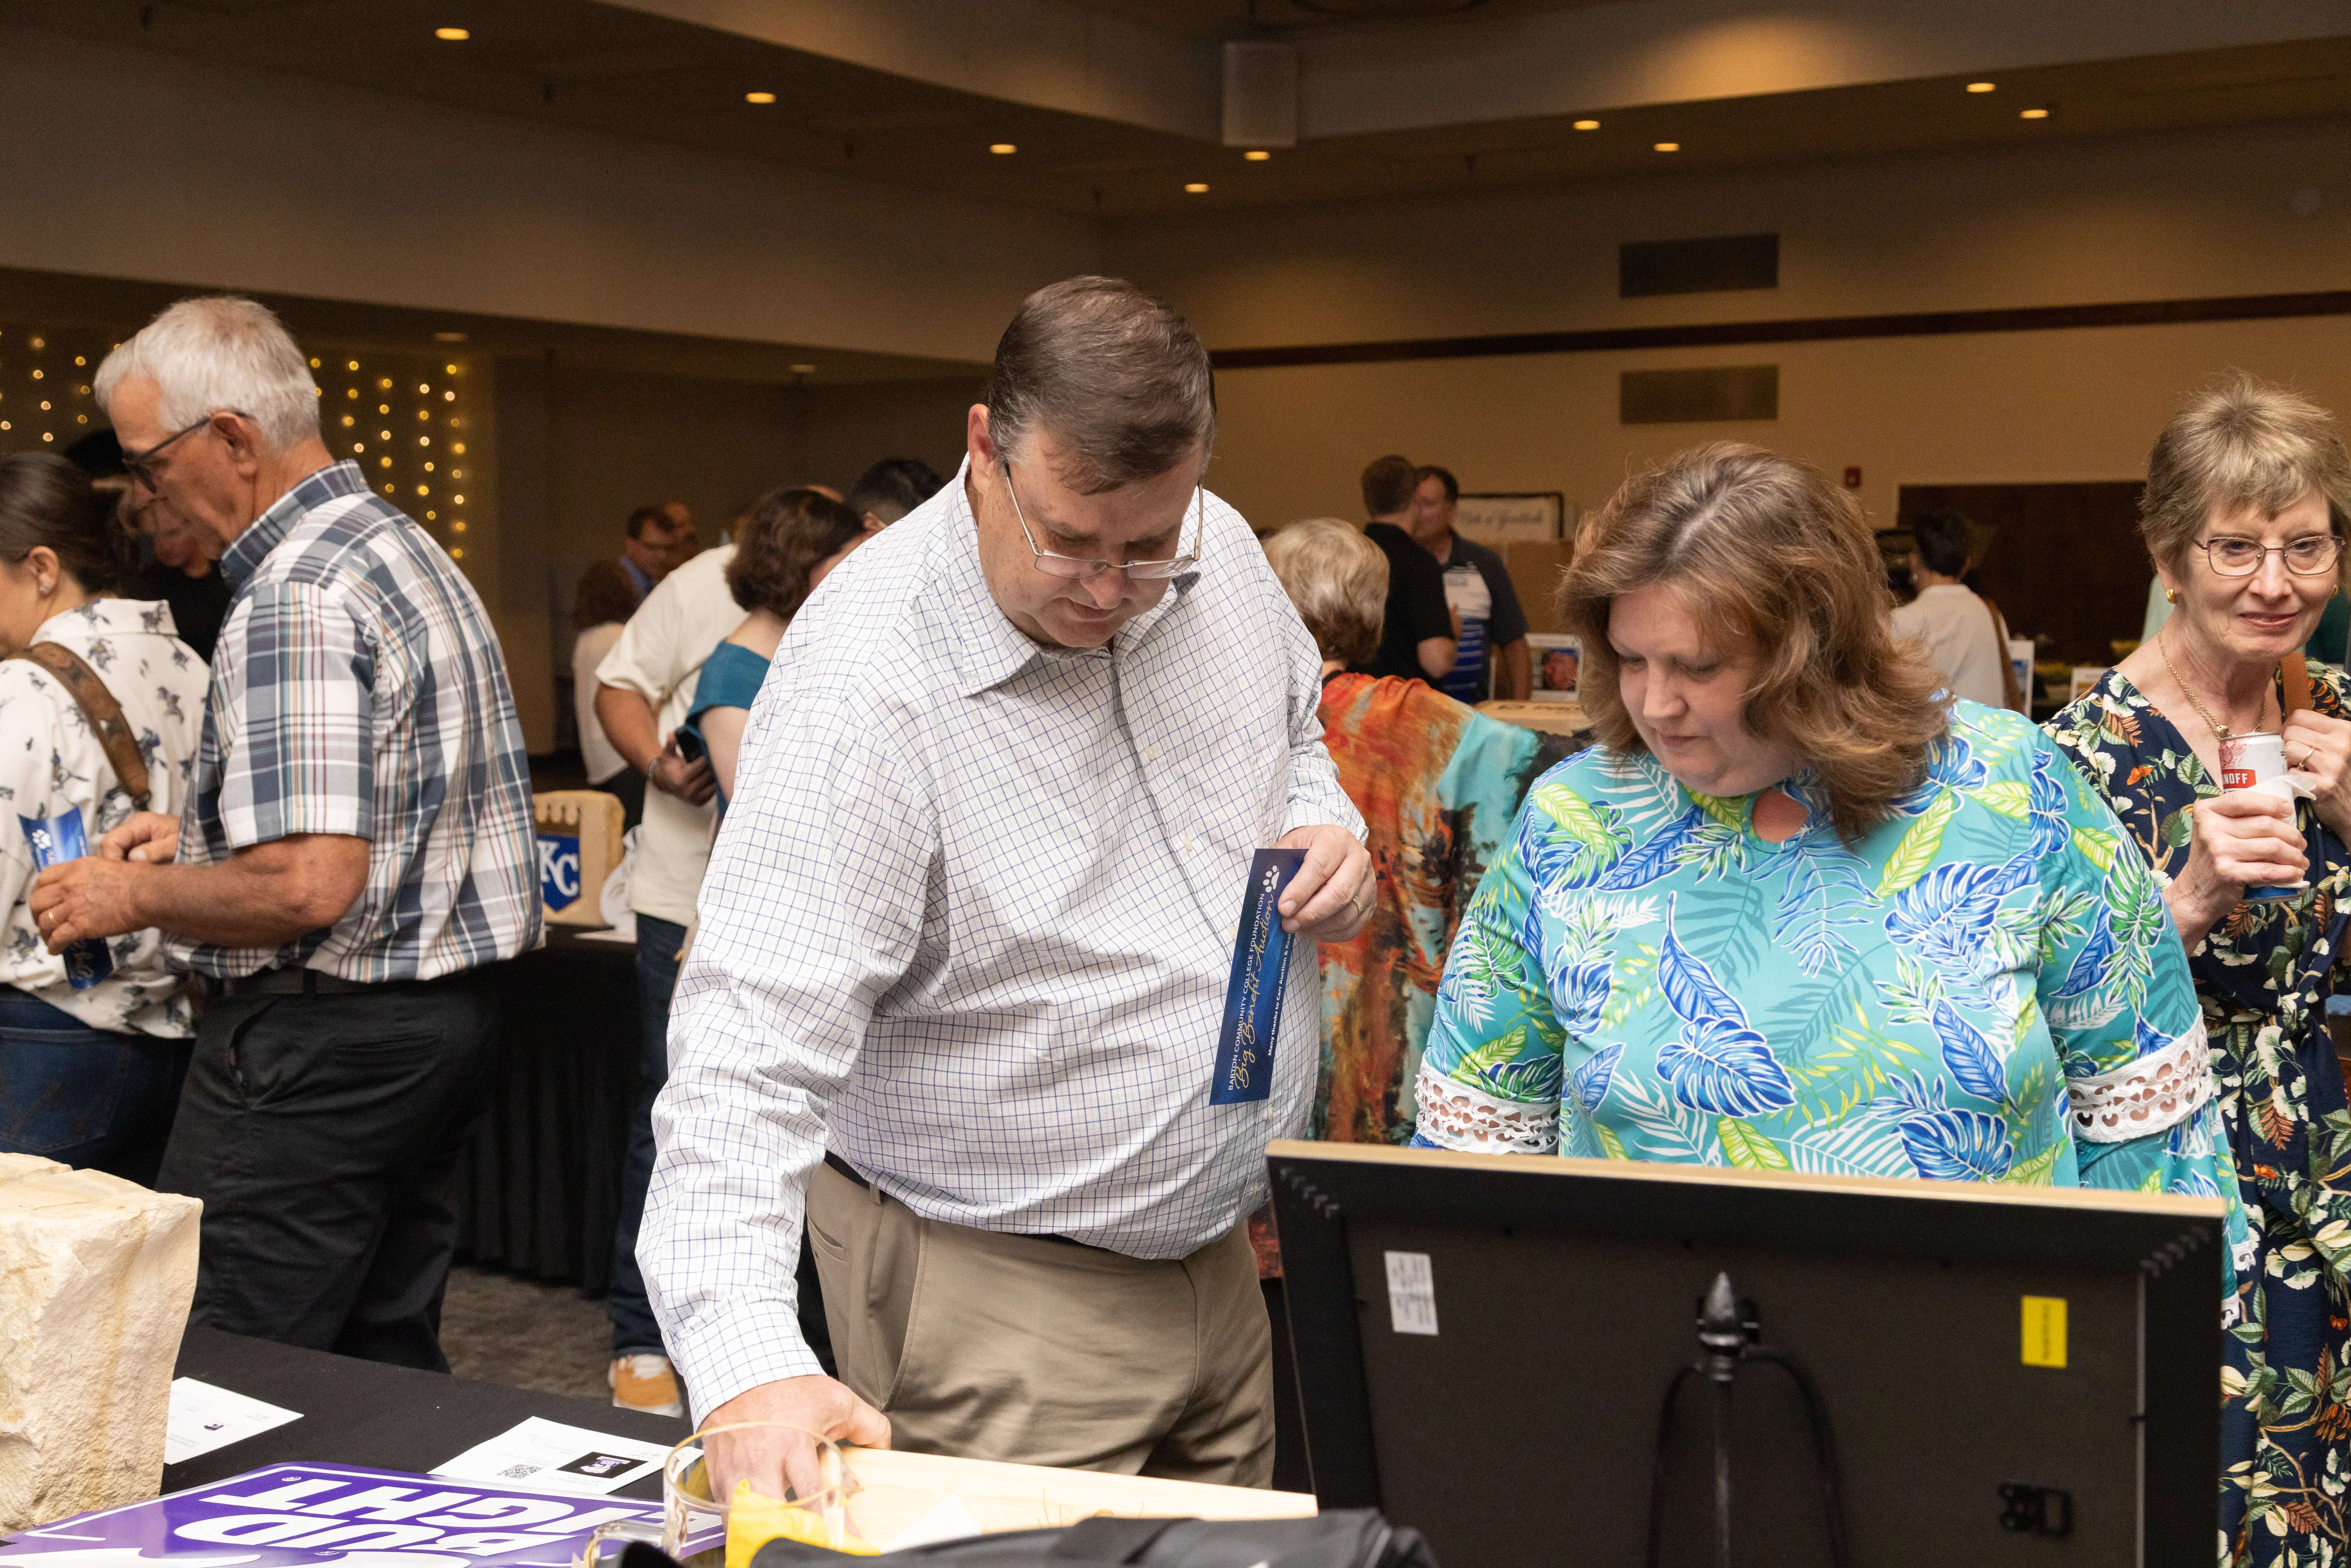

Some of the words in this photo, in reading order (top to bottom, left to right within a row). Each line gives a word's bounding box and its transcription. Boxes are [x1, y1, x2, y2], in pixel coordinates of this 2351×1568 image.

[2222, 773, 2248, 784] NOFF
[536, 840, 579, 897] KC
[1254, 894, 1274, 971] Auction
[1228, 1055, 1238, 1090] BARTON
[1234, 996, 1246, 1052] COMMUNITY
[1244, 955, 1253, 994] COLLEGE
[1250, 894, 1265, 952] FOUNDATION
[1241, 971, 1260, 1045] Benefit
[1234, 1049, 1255, 1089] Big
[174, 1514, 577, 1556] BUD
